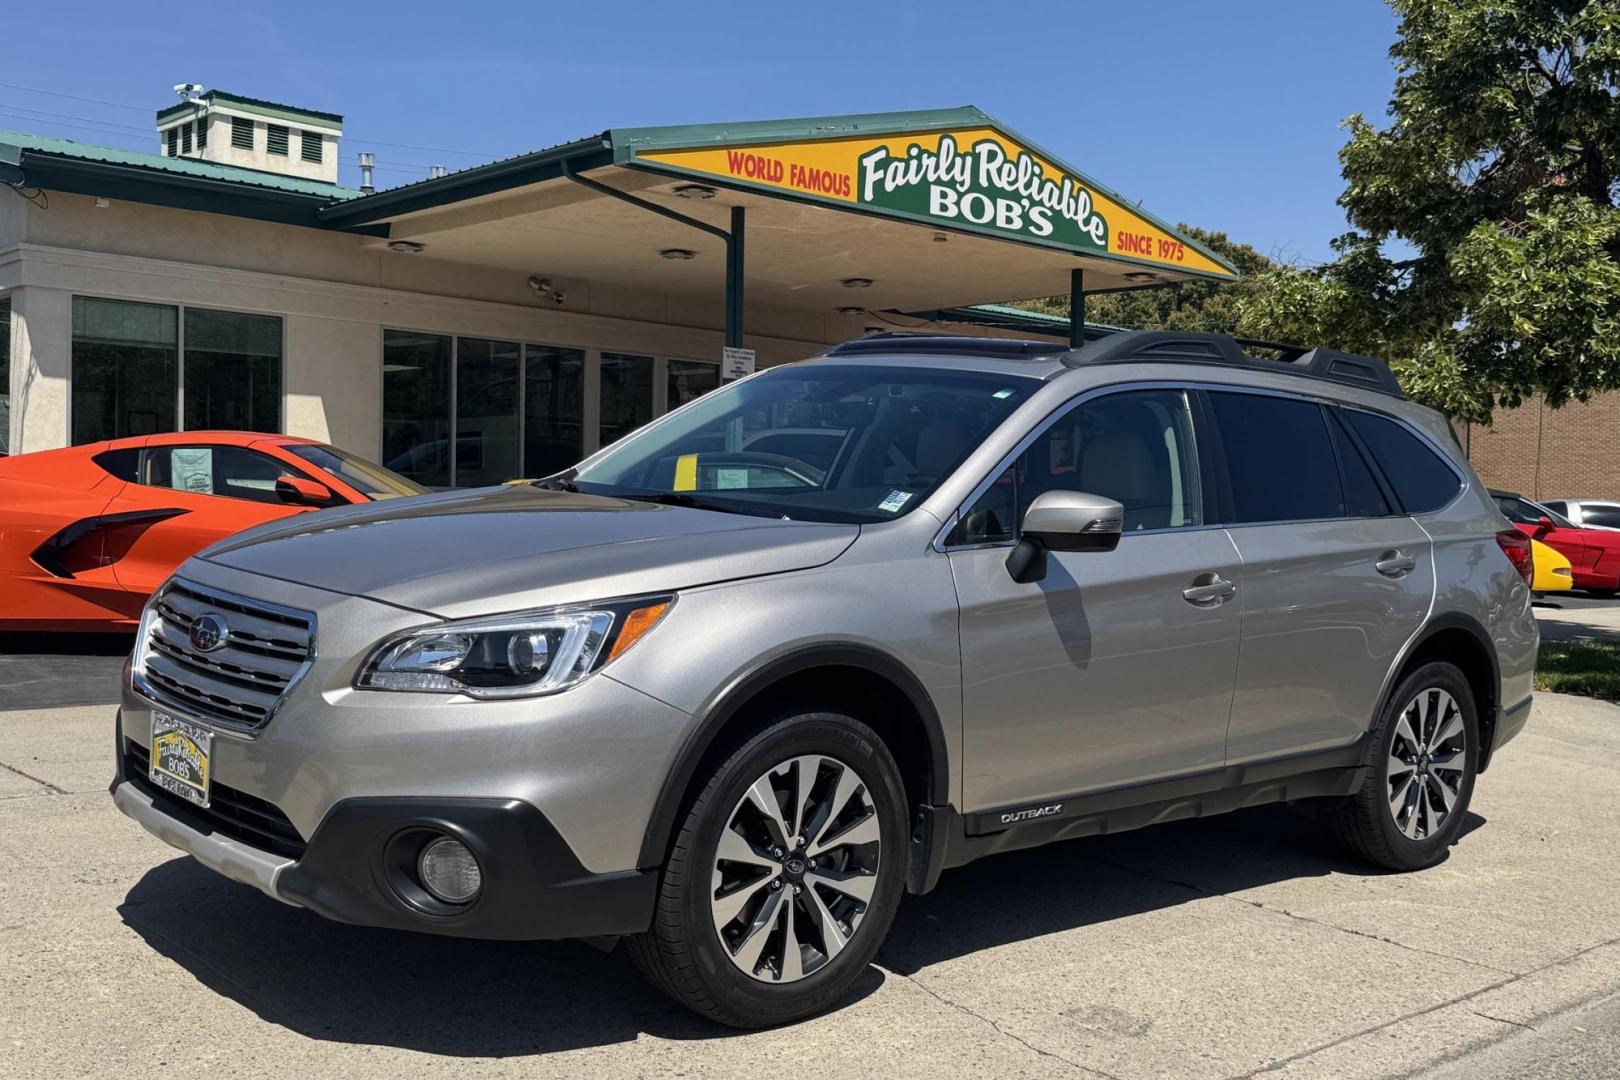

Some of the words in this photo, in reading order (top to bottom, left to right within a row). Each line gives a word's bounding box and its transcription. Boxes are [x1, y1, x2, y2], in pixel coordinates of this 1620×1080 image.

[727, 150, 784, 183] WORLD
[790, 163, 851, 198] FAMOUS
[862, 137, 972, 202] Fairly
[975, 142, 1106, 245] Reliable
[929, 184, 1054, 236] BOB'S
[1117, 231, 1153, 256] SINCE
[1157, 238, 1185, 262] 1975
[168, 757, 190, 779] BOB'S
[1001, 804, 1062, 823] OUTBACK
